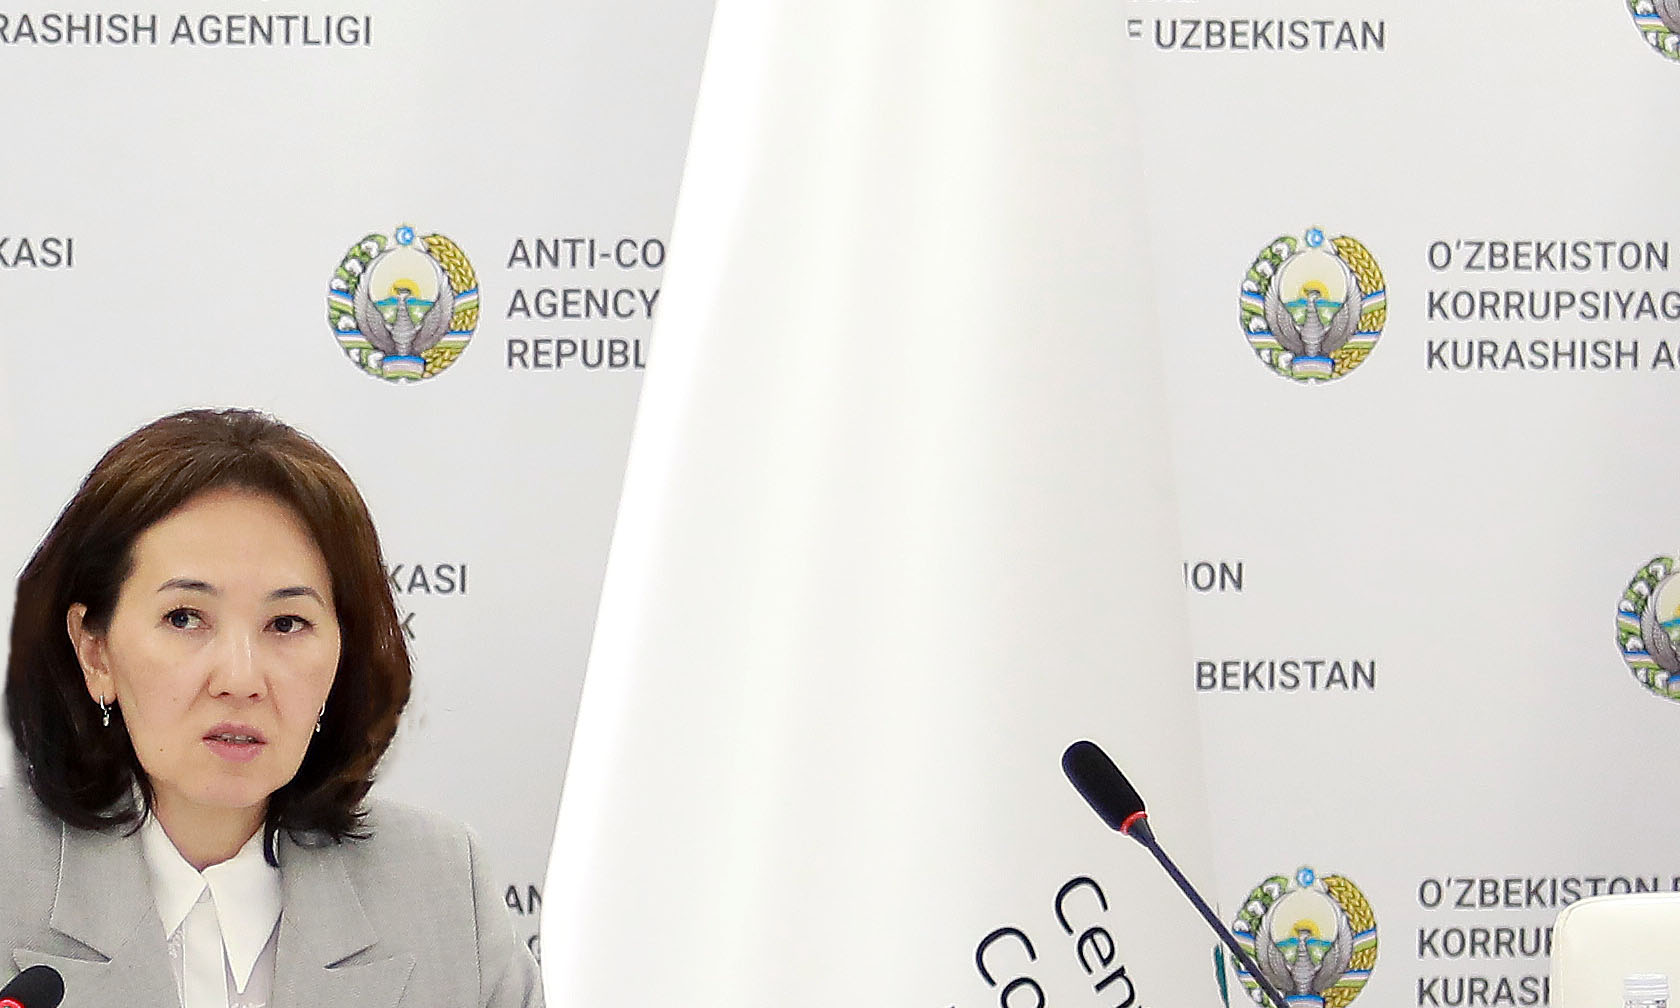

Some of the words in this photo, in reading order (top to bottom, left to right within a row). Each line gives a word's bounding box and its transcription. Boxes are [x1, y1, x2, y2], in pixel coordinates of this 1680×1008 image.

[169, 14, 372, 47] AGENTLIGI
[1154, 18, 1385, 51] UZBEKISTAN
[506, 287, 661, 320] AGENCY
[1426, 338, 1639, 371] KURASHISH
